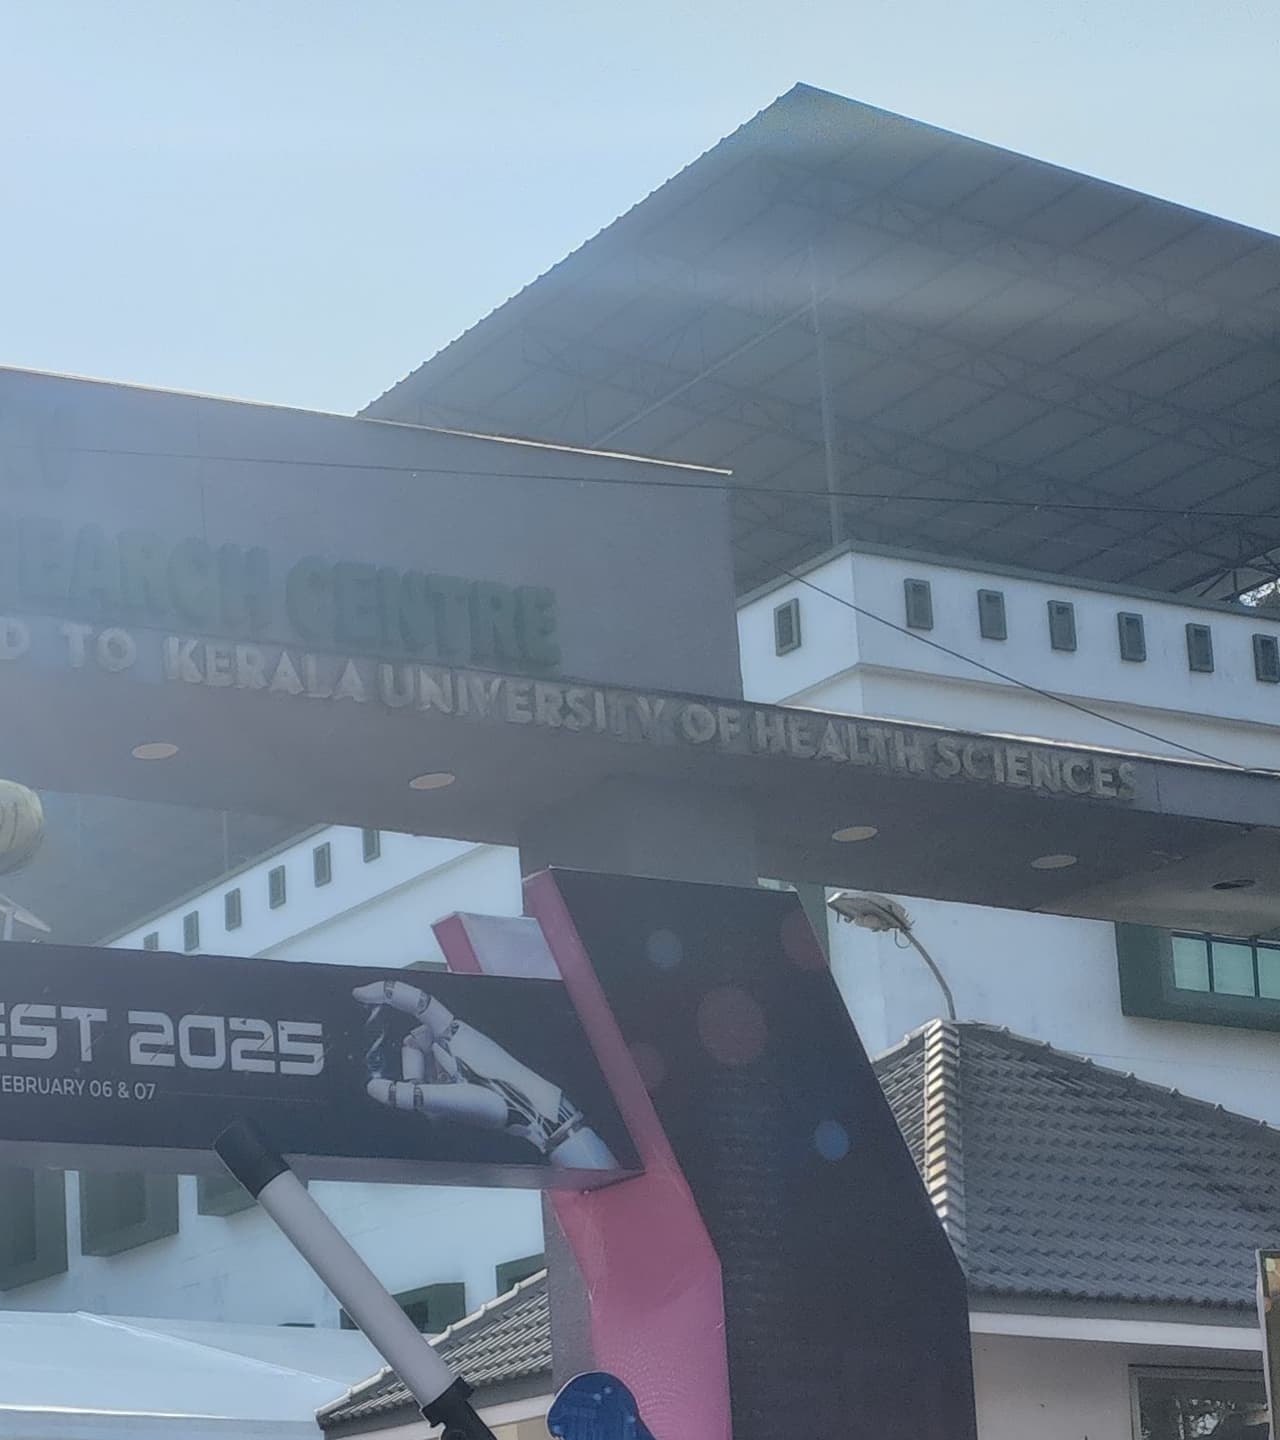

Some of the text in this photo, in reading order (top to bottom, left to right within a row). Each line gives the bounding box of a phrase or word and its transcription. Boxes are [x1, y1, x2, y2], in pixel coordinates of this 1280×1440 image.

[284, 552, 561, 670] CENTRE
[58, 619, 138, 674] TO
[162, 634, 367, 706] KERALA
[380, 661, 673, 750] UNIVERSITY
[680, 700, 745, 750] OF
[753, 716, 928, 777] HEALTH
[932, 727, 1140, 802] SCIENCES
[128, 1010, 325, 1076] 2025
[89, 1078, 114, 1099] 06
[117, 1081, 131, 1099] &
[134, 1081, 157, 1101] 07
